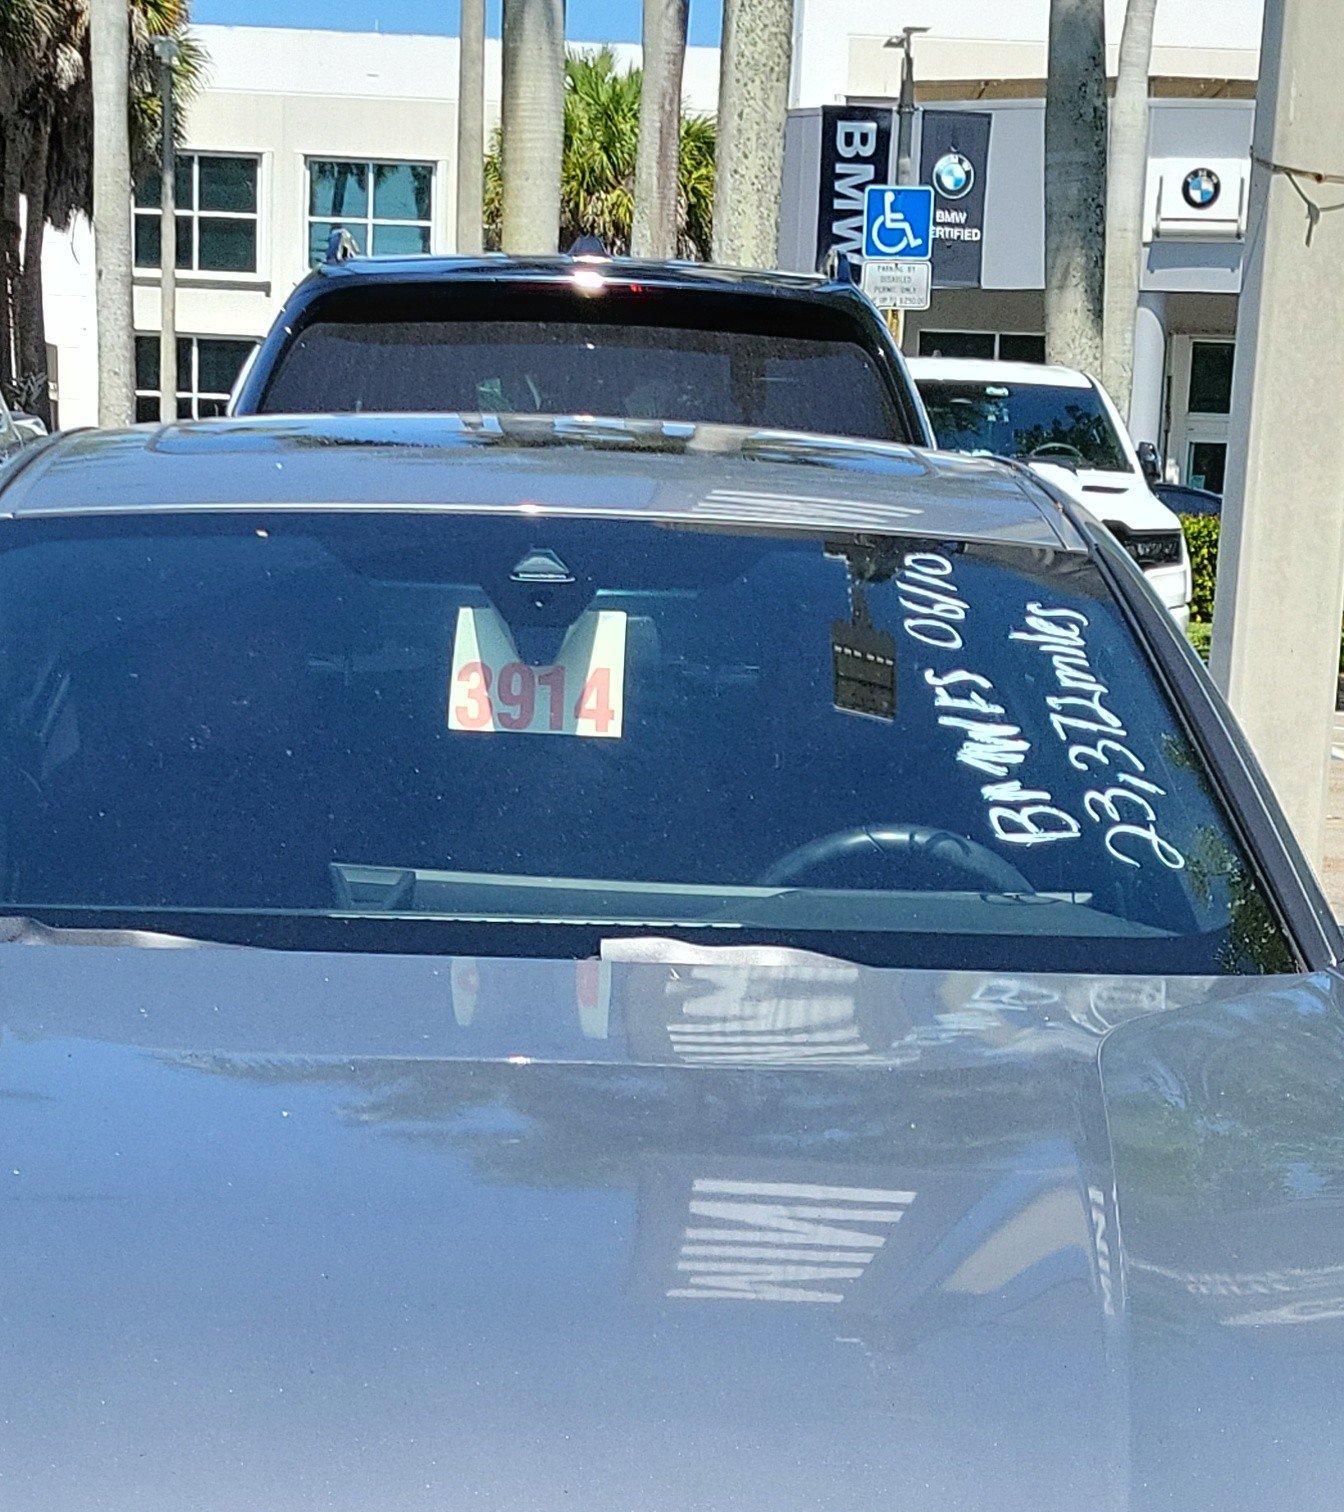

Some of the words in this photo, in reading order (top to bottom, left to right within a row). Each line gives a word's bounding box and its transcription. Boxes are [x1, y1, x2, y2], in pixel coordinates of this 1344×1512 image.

[936, 209, 967, 224] BMW
[929, 225, 981, 241] ERTIFIED
[455, 661, 615, 733] 3914
